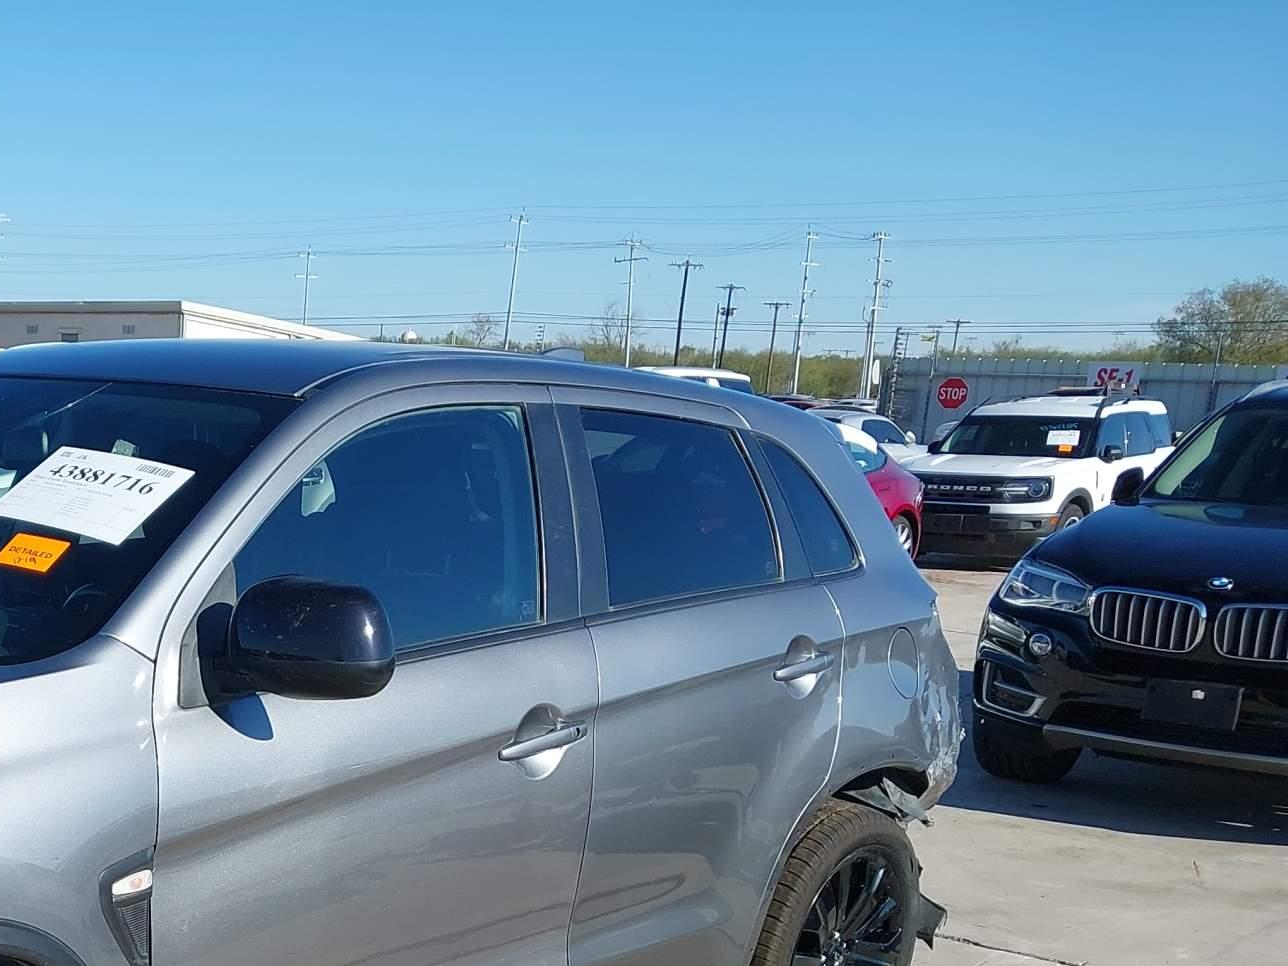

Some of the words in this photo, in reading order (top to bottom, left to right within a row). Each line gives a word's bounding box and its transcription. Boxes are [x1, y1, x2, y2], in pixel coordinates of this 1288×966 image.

[939, 387, 967, 400] STOP
[49, 463, 160, 495] 43881716
[927, 484, 992, 492] RONCO
[8, 545, 53, 559] DETAILED
